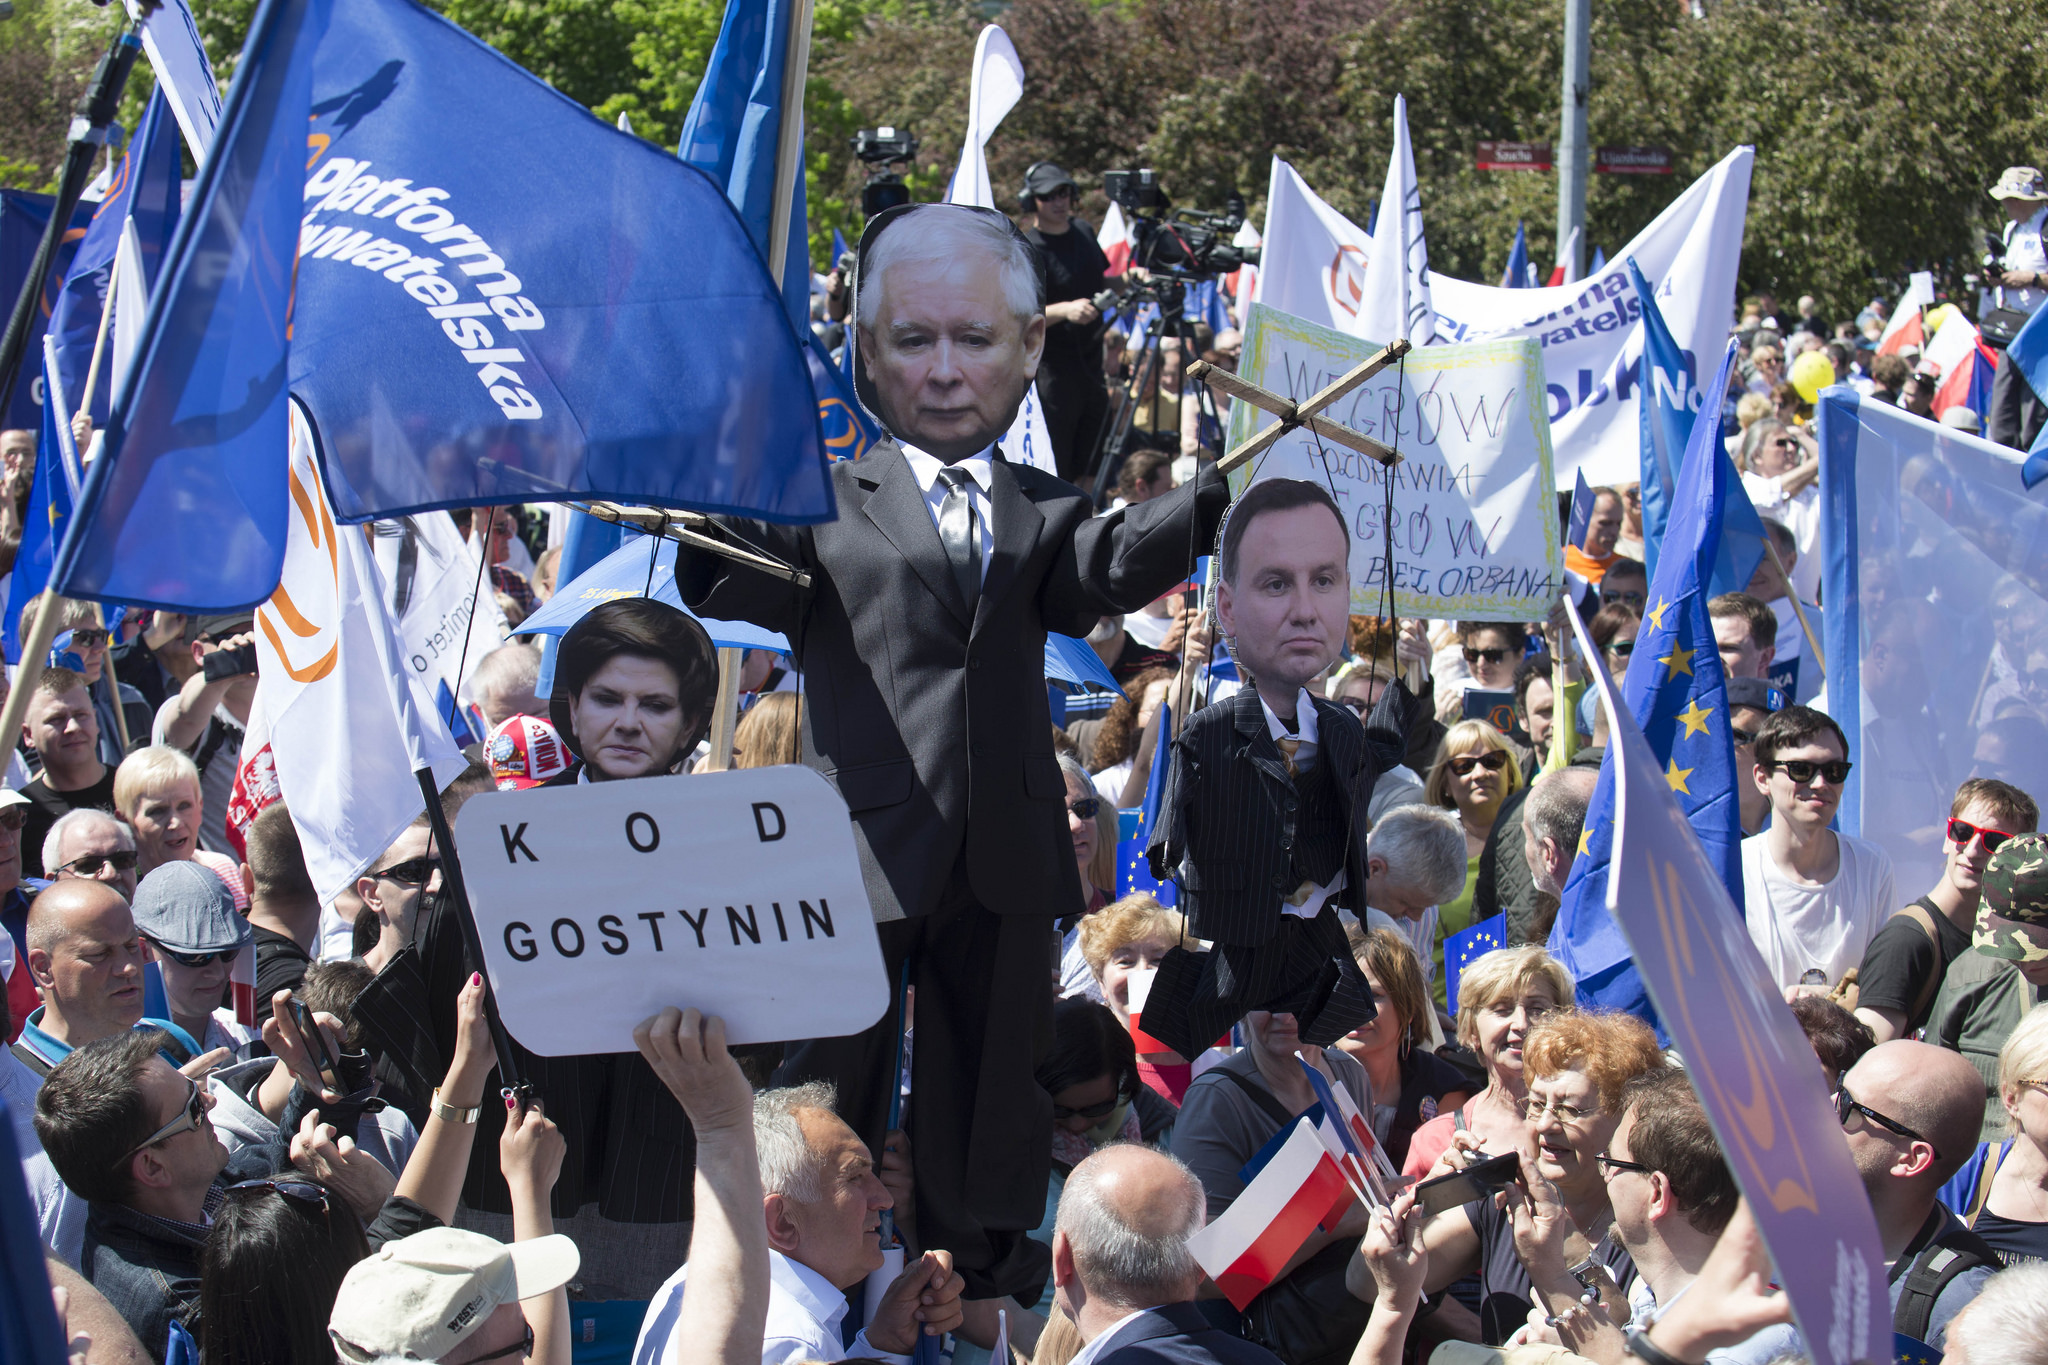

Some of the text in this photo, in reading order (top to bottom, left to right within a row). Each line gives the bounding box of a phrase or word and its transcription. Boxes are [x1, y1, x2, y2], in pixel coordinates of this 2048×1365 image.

[299, 213, 543, 420] ywatelska
[303, 157, 545, 331] Platforma
[503, 898, 836, 962] GOSTYNIN
